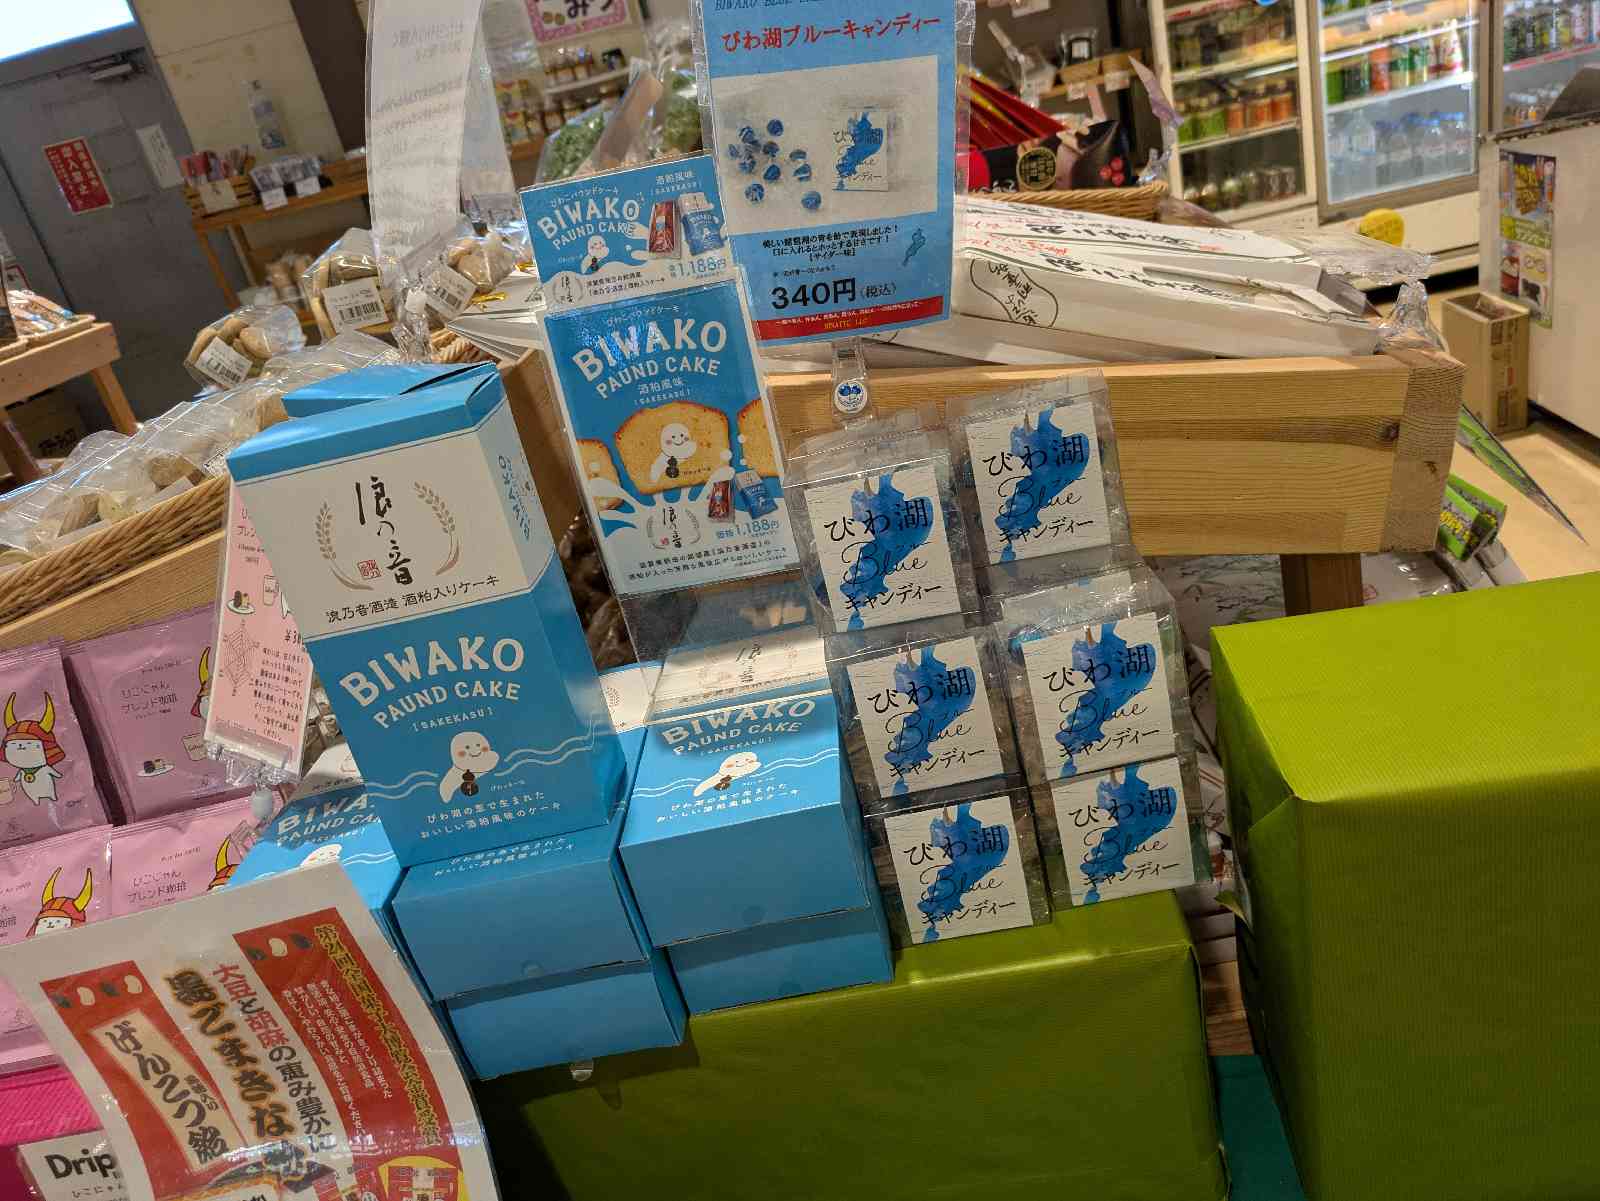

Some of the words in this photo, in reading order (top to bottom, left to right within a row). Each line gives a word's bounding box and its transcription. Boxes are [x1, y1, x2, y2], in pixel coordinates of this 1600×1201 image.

[722, 13, 940, 52] びわ湖ブルーキャンディー
[536, 197, 640, 239] BIWAKO
[553, 223, 594, 249] PAUND
[599, 221, 636, 238] CAKE
[771, 277, 856, 309] 340円
[572, 318, 727, 382] BIWAKO
[596, 359, 659, 399] PAUND
[665, 357, 721, 376] CAKE
[983, 435, 1084, 476] びわ湖
[997, 476, 1083, 518] Blue
[824, 498, 928, 542] びわ湖
[1000, 516, 1094, 544] キャンディー
[841, 541, 929, 584] Blue
[326, 598, 399, 623] 浪乃音酒造
[402, 575, 501, 608] 酒粕入りケーキ
[845, 583, 942, 612] キャンディー
[339, 636, 524, 706] BIWAKO
[1043, 645, 1151, 691] びわ湖
[373, 686, 448, 728] PAUND
[455, 680, 521, 701] CAKE
[867, 670, 971, 713] びわ湖
[661, 699, 816, 744] BIWAKO
[885, 711, 972, 754] Blue
[1058, 690, 1149, 735] Blue
[673, 728, 743, 755] PAUND
[748, 722, 802, 733] CAKE
[1059, 728, 1160, 758] キャンディー
[889, 749, 985, 778] キャンディー
[277, 794, 375, 834] BIWA
[1069, 787, 1172, 827] びわ湖
[277, 816, 346, 846] PAUND
[904, 826, 1003, 866] びわ湖
[1083, 826, 1168, 865] Blue
[919, 865, 1005, 904] Blue
[1084, 862, 1181, 887] キャンディー
[922, 899, 1017, 925] キャンディー
[212, 962, 338, 1153] 大豆と胡麻の恵み豊かに
[45, 1147, 114, 1182] Drip
